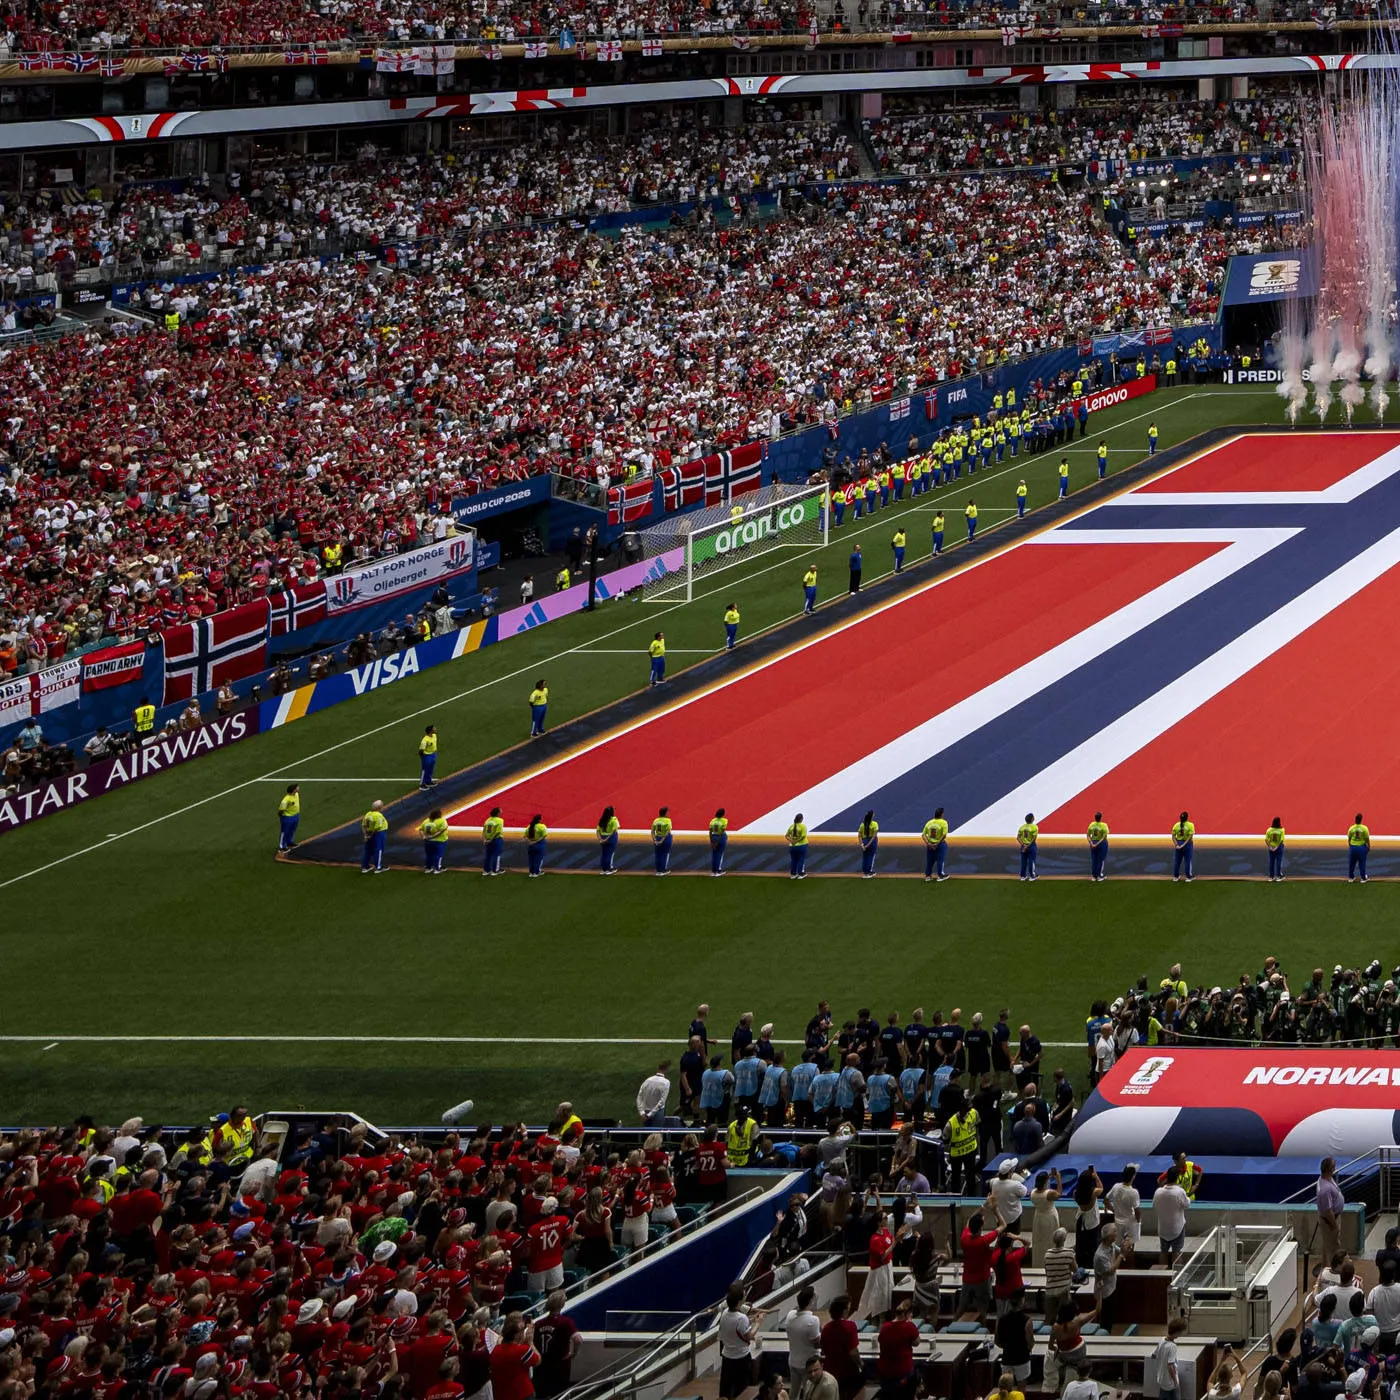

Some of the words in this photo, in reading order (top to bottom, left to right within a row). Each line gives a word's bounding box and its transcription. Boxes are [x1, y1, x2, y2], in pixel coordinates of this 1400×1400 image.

[948, 388, 967, 403] FIFA
[1085, 388, 1128, 413] Lenovo
[459, 501, 487, 519] WORLD
[488, 497, 505, 509] CUP
[505, 489, 532, 503] 2026
[360, 569, 380, 581] ALT
[383, 561, 407, 575] FOR
[408, 547, 445, 565] NORGE
[373, 568, 428, 592] Oljeberget
[85, 662, 116, 678] PARMO
[117, 653, 144, 670] ARMY
[344, 649, 419, 696] VISA
[0, 693, 31, 711] OTTS
[33, 676, 77, 699] COUNTY
[105, 712, 246, 788] AIRWAYS
[700, 1157, 716, 1172] 22
[541, 1229, 559, 1250] 10
